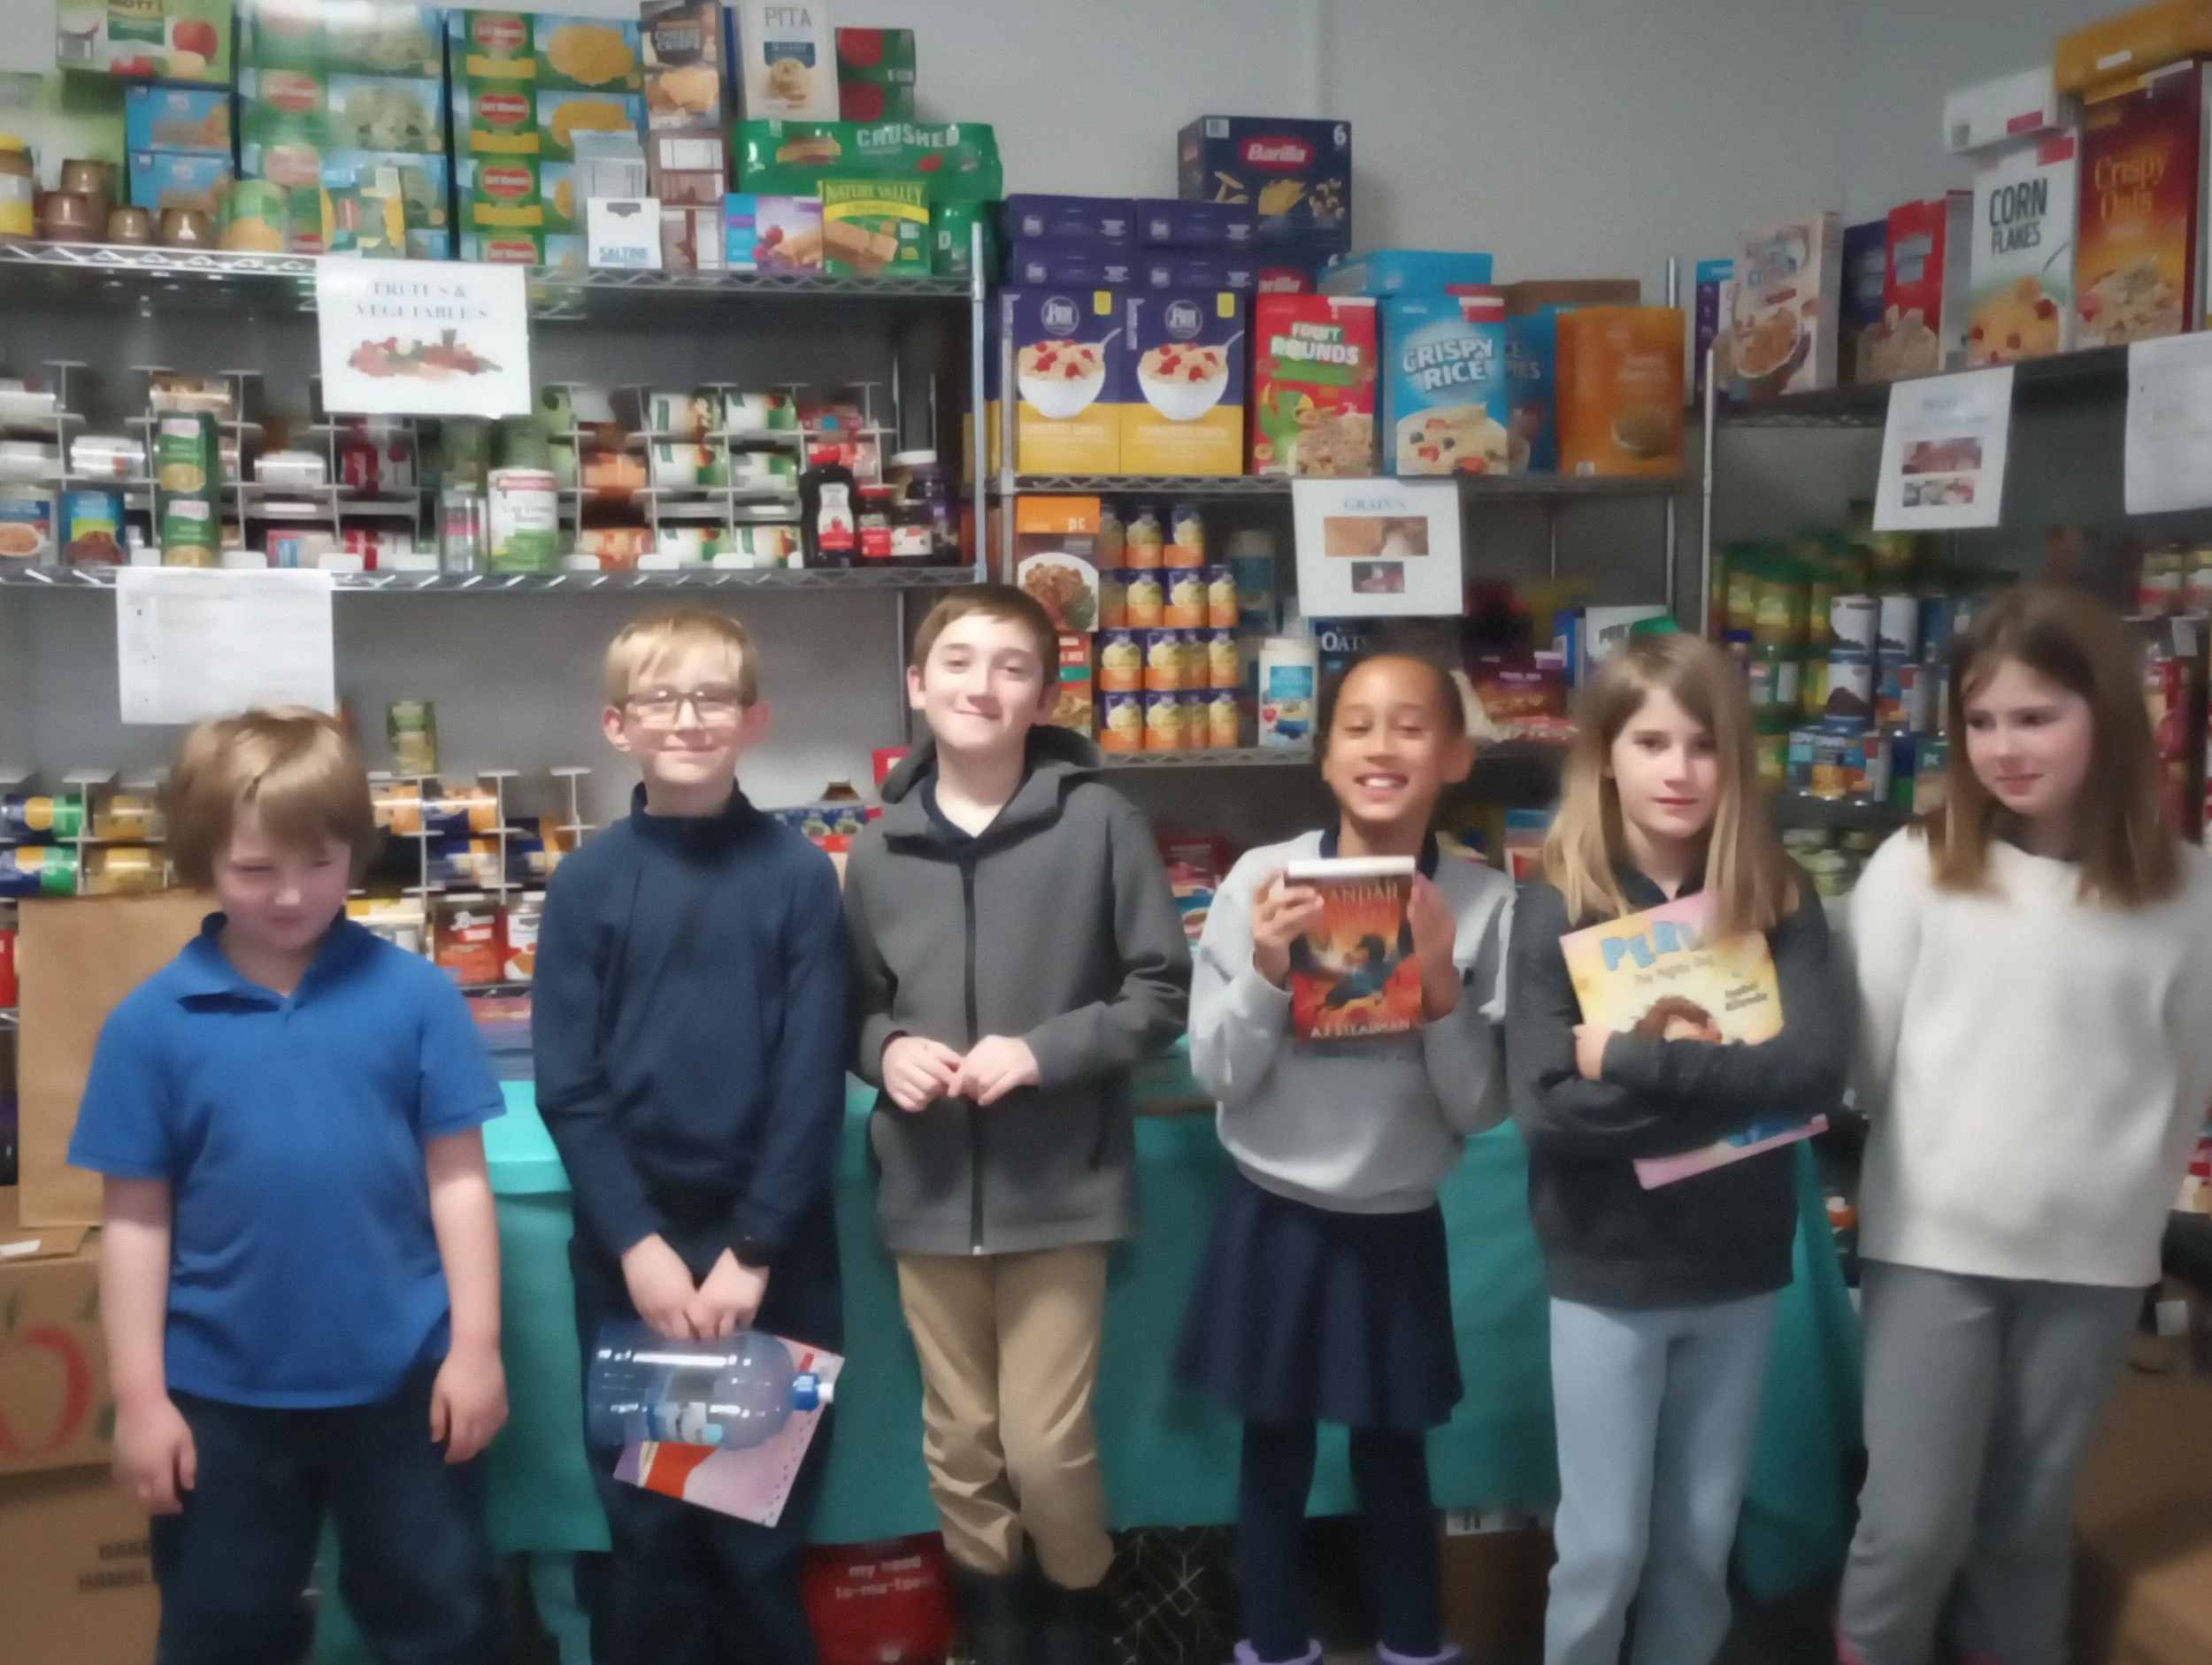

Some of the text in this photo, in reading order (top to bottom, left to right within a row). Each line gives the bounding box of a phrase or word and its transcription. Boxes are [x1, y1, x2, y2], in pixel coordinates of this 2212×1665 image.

[764, 7, 812, 27] PITA
[856, 124, 959, 148] CRUSHED
[1333, 124, 1347, 146] 6
[1247, 143, 1307, 163] Barilla
[2094, 147, 2170, 192] Crispy
[825, 183, 925, 211] NATURE VALLEY
[1989, 178, 2047, 227] CORN
[1992, 221, 2041, 255] FLAKES
[1258, 277, 1302, 293] arilla
[1291, 321, 1342, 341] FRUIT
[1271, 335, 1360, 366] ROUNDS
[1402, 339, 1494, 372] CRISPY
[1424, 360, 1487, 390] RICE
